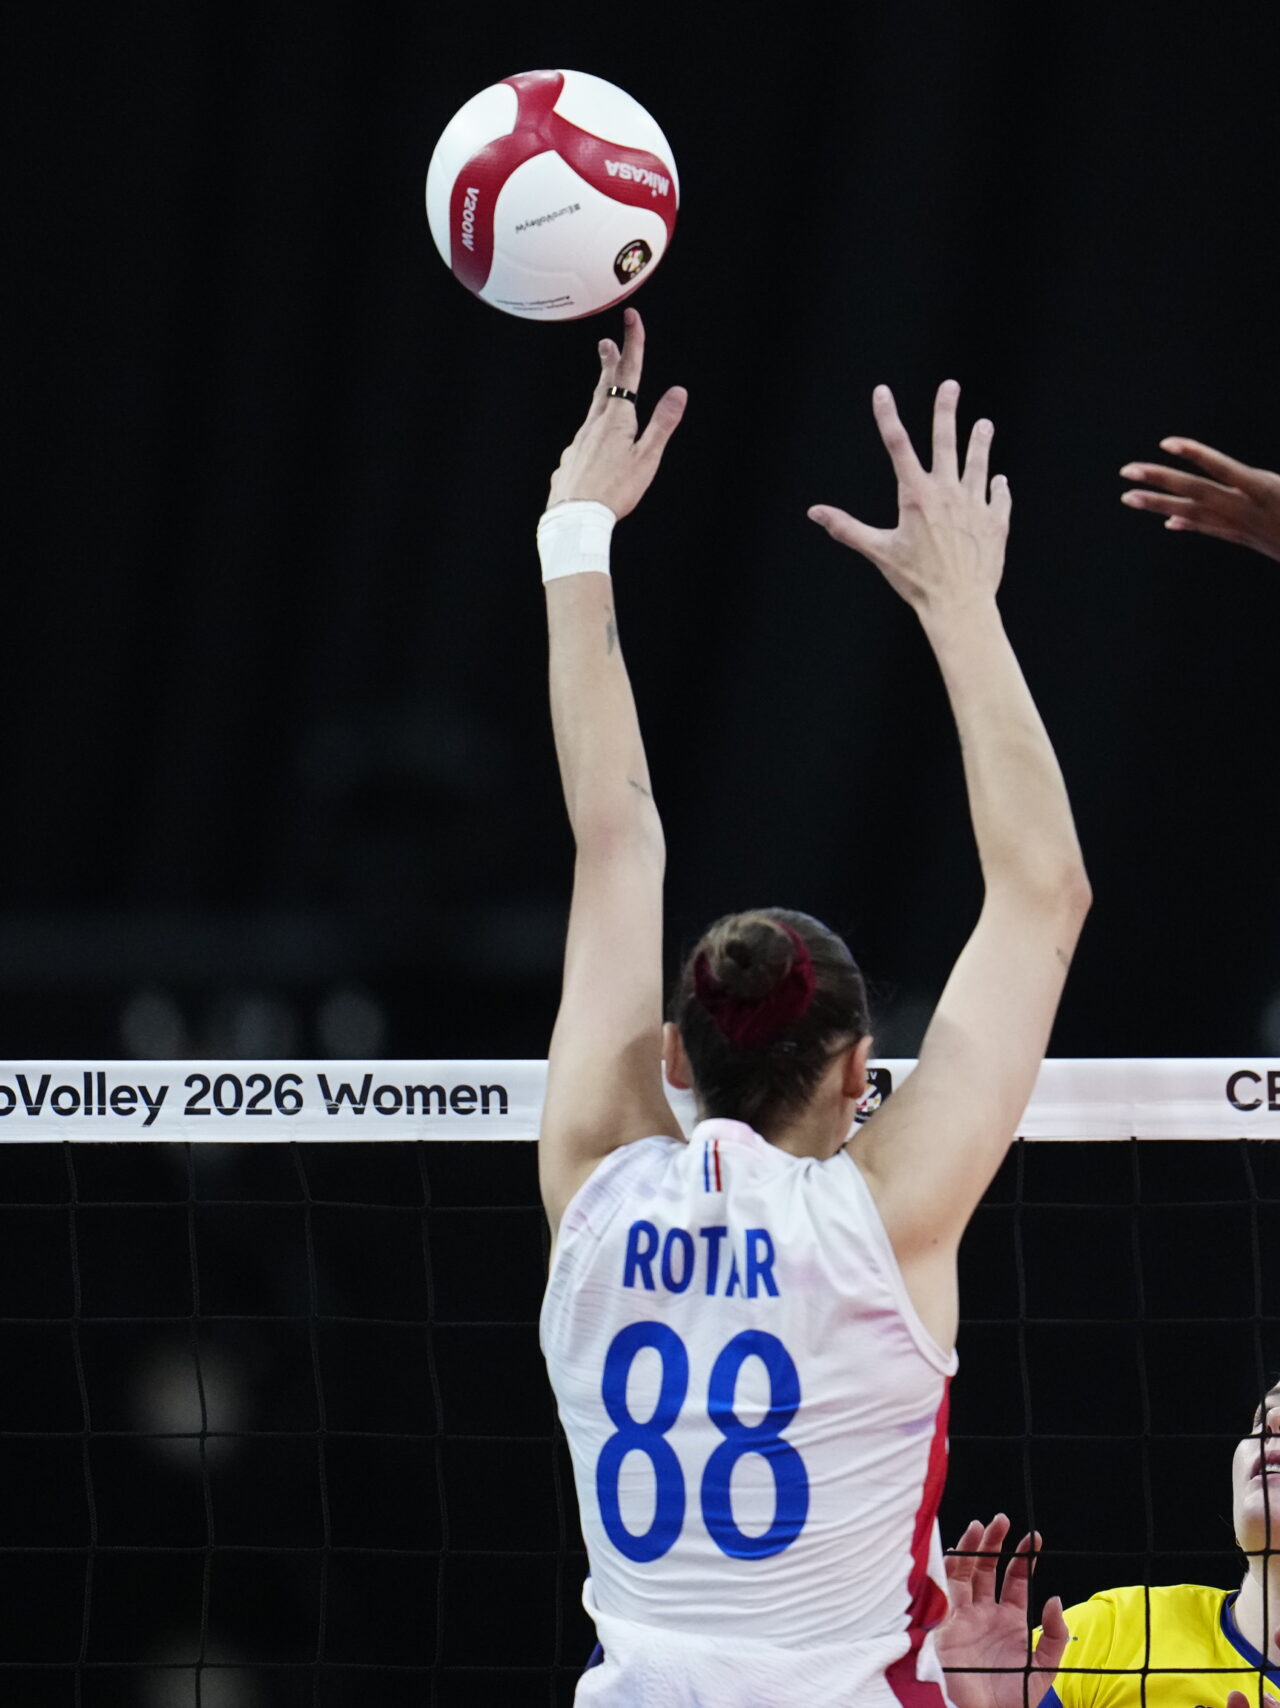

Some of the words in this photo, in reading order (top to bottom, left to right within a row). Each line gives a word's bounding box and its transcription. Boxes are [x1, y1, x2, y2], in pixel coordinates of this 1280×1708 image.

[461, 187, 480, 251] V200W
[184, 1073, 303, 1116] 2026
[318, 1073, 509, 1116] Women
[596, 1321, 810, 1563] 88
